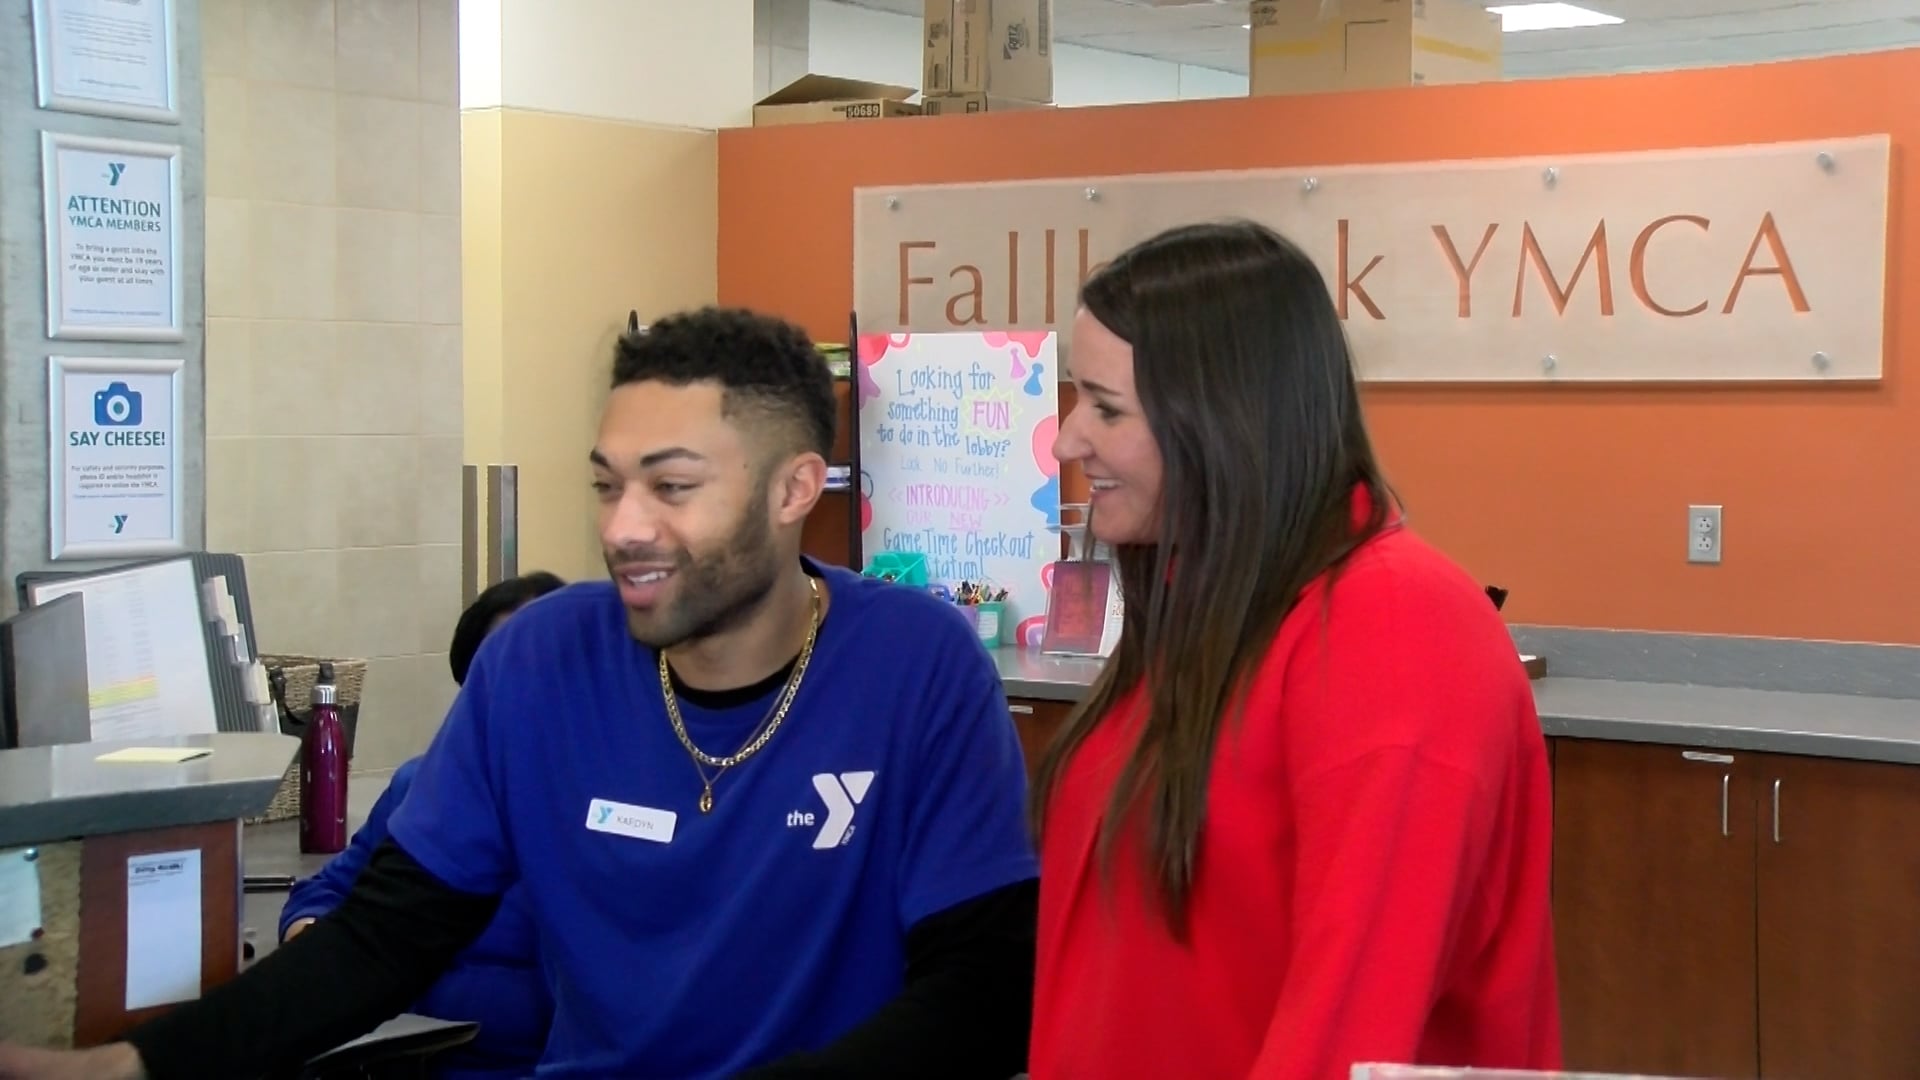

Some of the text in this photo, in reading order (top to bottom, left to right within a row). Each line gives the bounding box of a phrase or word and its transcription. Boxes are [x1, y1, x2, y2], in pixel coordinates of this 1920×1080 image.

[68, 195, 161, 218] ATTENTION
[69, 215, 161, 232] YMCA MEMBERS
[899, 210, 1811, 326] Fallk YMCA
[896, 361, 996, 400] Looking for
[887, 397, 1010, 430] something FUN
[70, 431, 165, 446] SAY CHEESE!
[877, 423, 1011, 457] to do in the lobby?
[934, 457, 948, 473] No
[906, 483, 989, 511] INTRODUCING
[951, 511, 982, 528] NEW
[787, 809, 814, 826] the
